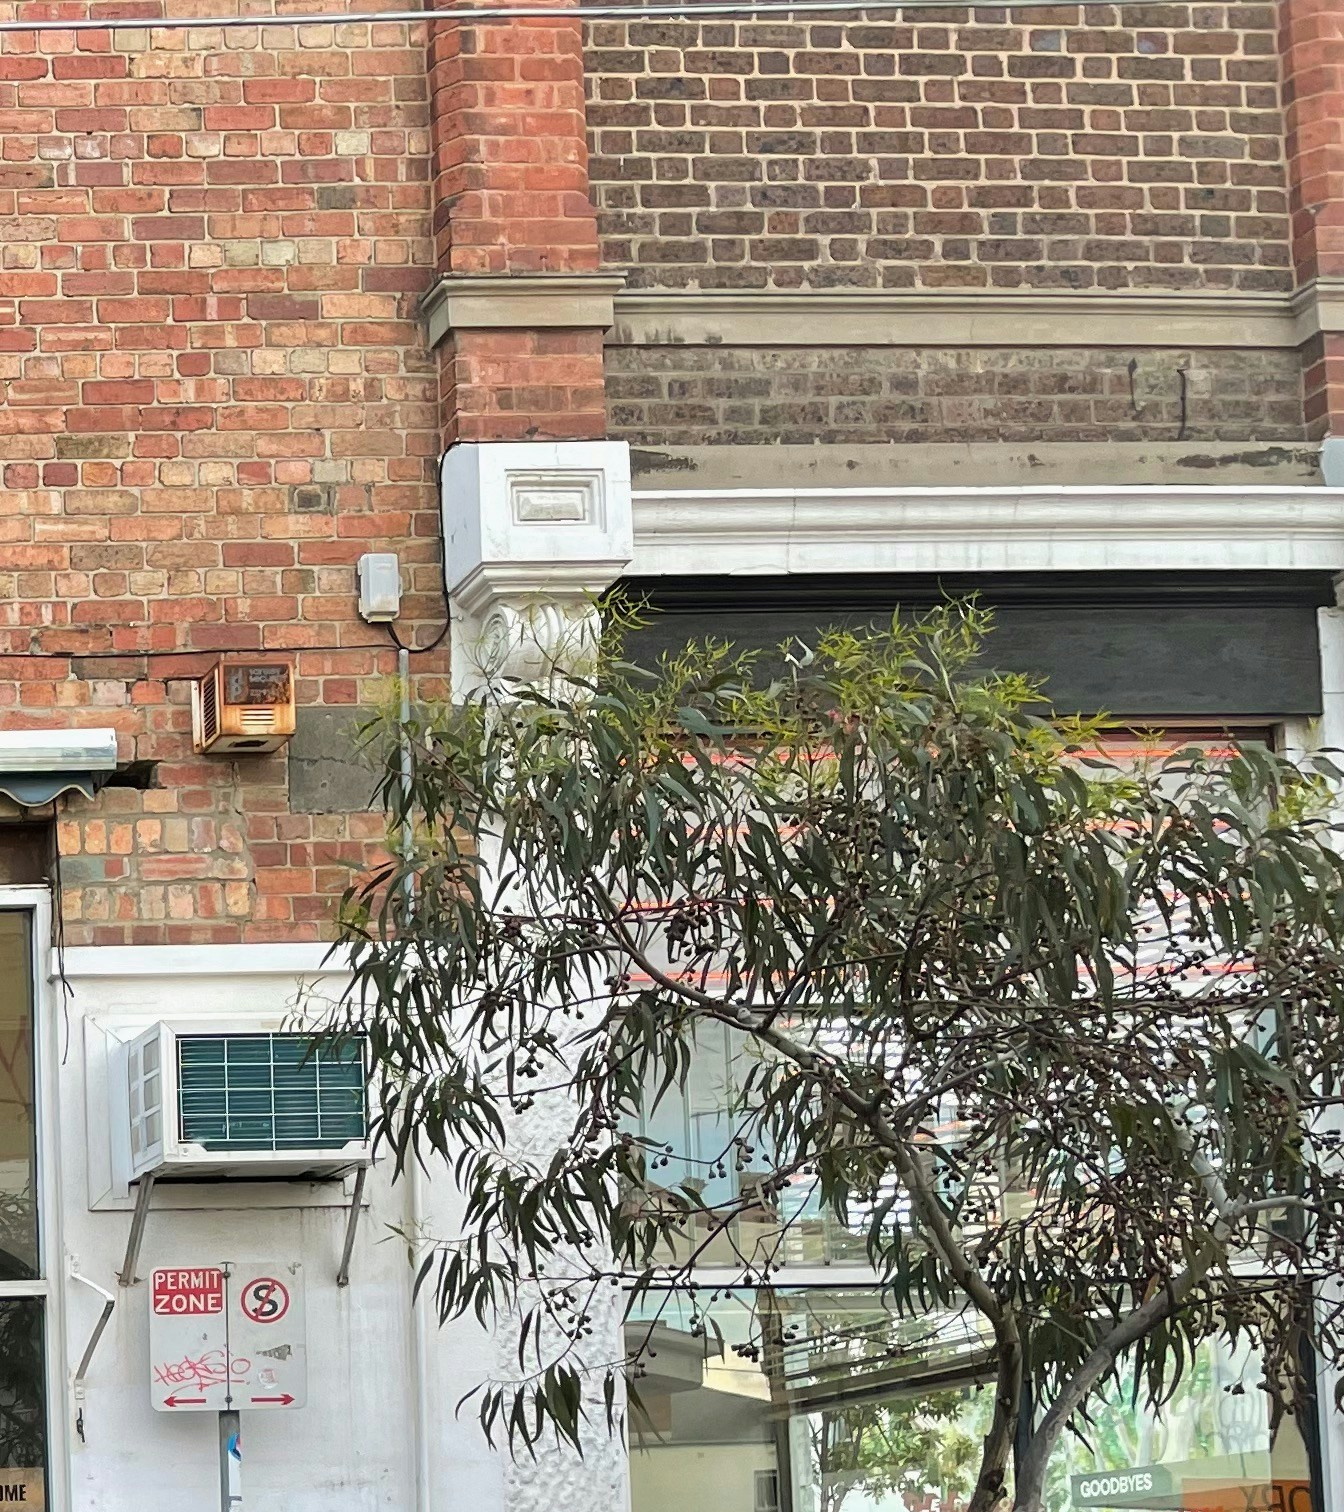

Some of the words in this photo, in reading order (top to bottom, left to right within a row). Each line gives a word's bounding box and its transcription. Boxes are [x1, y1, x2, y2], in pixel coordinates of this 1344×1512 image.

[154, 1270, 220, 1290] PERMIT
[155, 1293, 221, 1313] ZONE
[1080, 1473, 1153, 1498] GOODBYES
